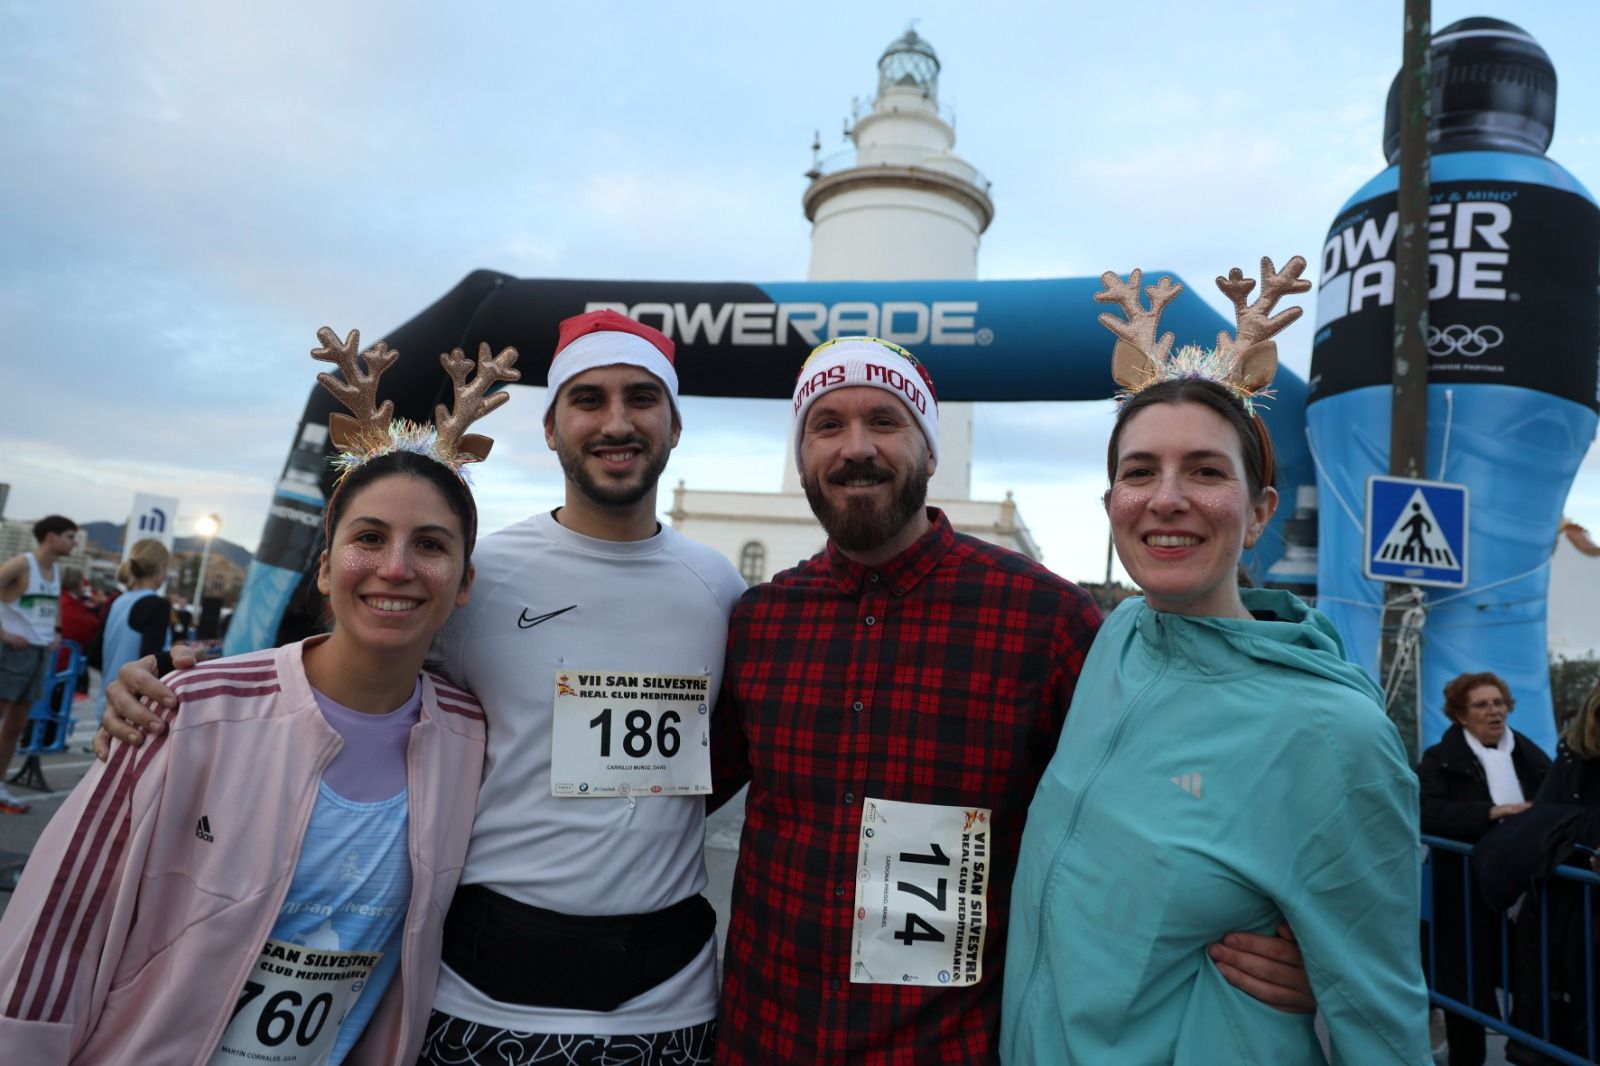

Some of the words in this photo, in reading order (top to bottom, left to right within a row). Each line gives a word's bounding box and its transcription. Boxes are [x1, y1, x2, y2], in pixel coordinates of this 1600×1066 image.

[1466, 191, 1512, 202] MIND
[1320, 201, 1512, 288] OWER
[866, 363, 926, 415] MOOD
[578, 675, 601, 687] VII
[606, 675, 638, 688] SAN
[643, 677, 708, 690] SILVESTRE
[580, 690, 609, 699] REAL
[611, 691, 638, 699] CLUB
[590, 708, 681, 758] 186
[961, 833, 970, 864] REAL
[974, 832, 986, 857] VII
[894, 843, 950, 946] 174
[959, 866, 968, 894] CLUB
[970, 862, 984, 896] SAN
[261, 942, 301, 964] SAN
[304, 953, 378, 968] SILVESTRE
[965, 900, 982, 983] SILVESTRE
[260, 961, 293, 977] CLUB
[223, 982, 334, 1047] 760
